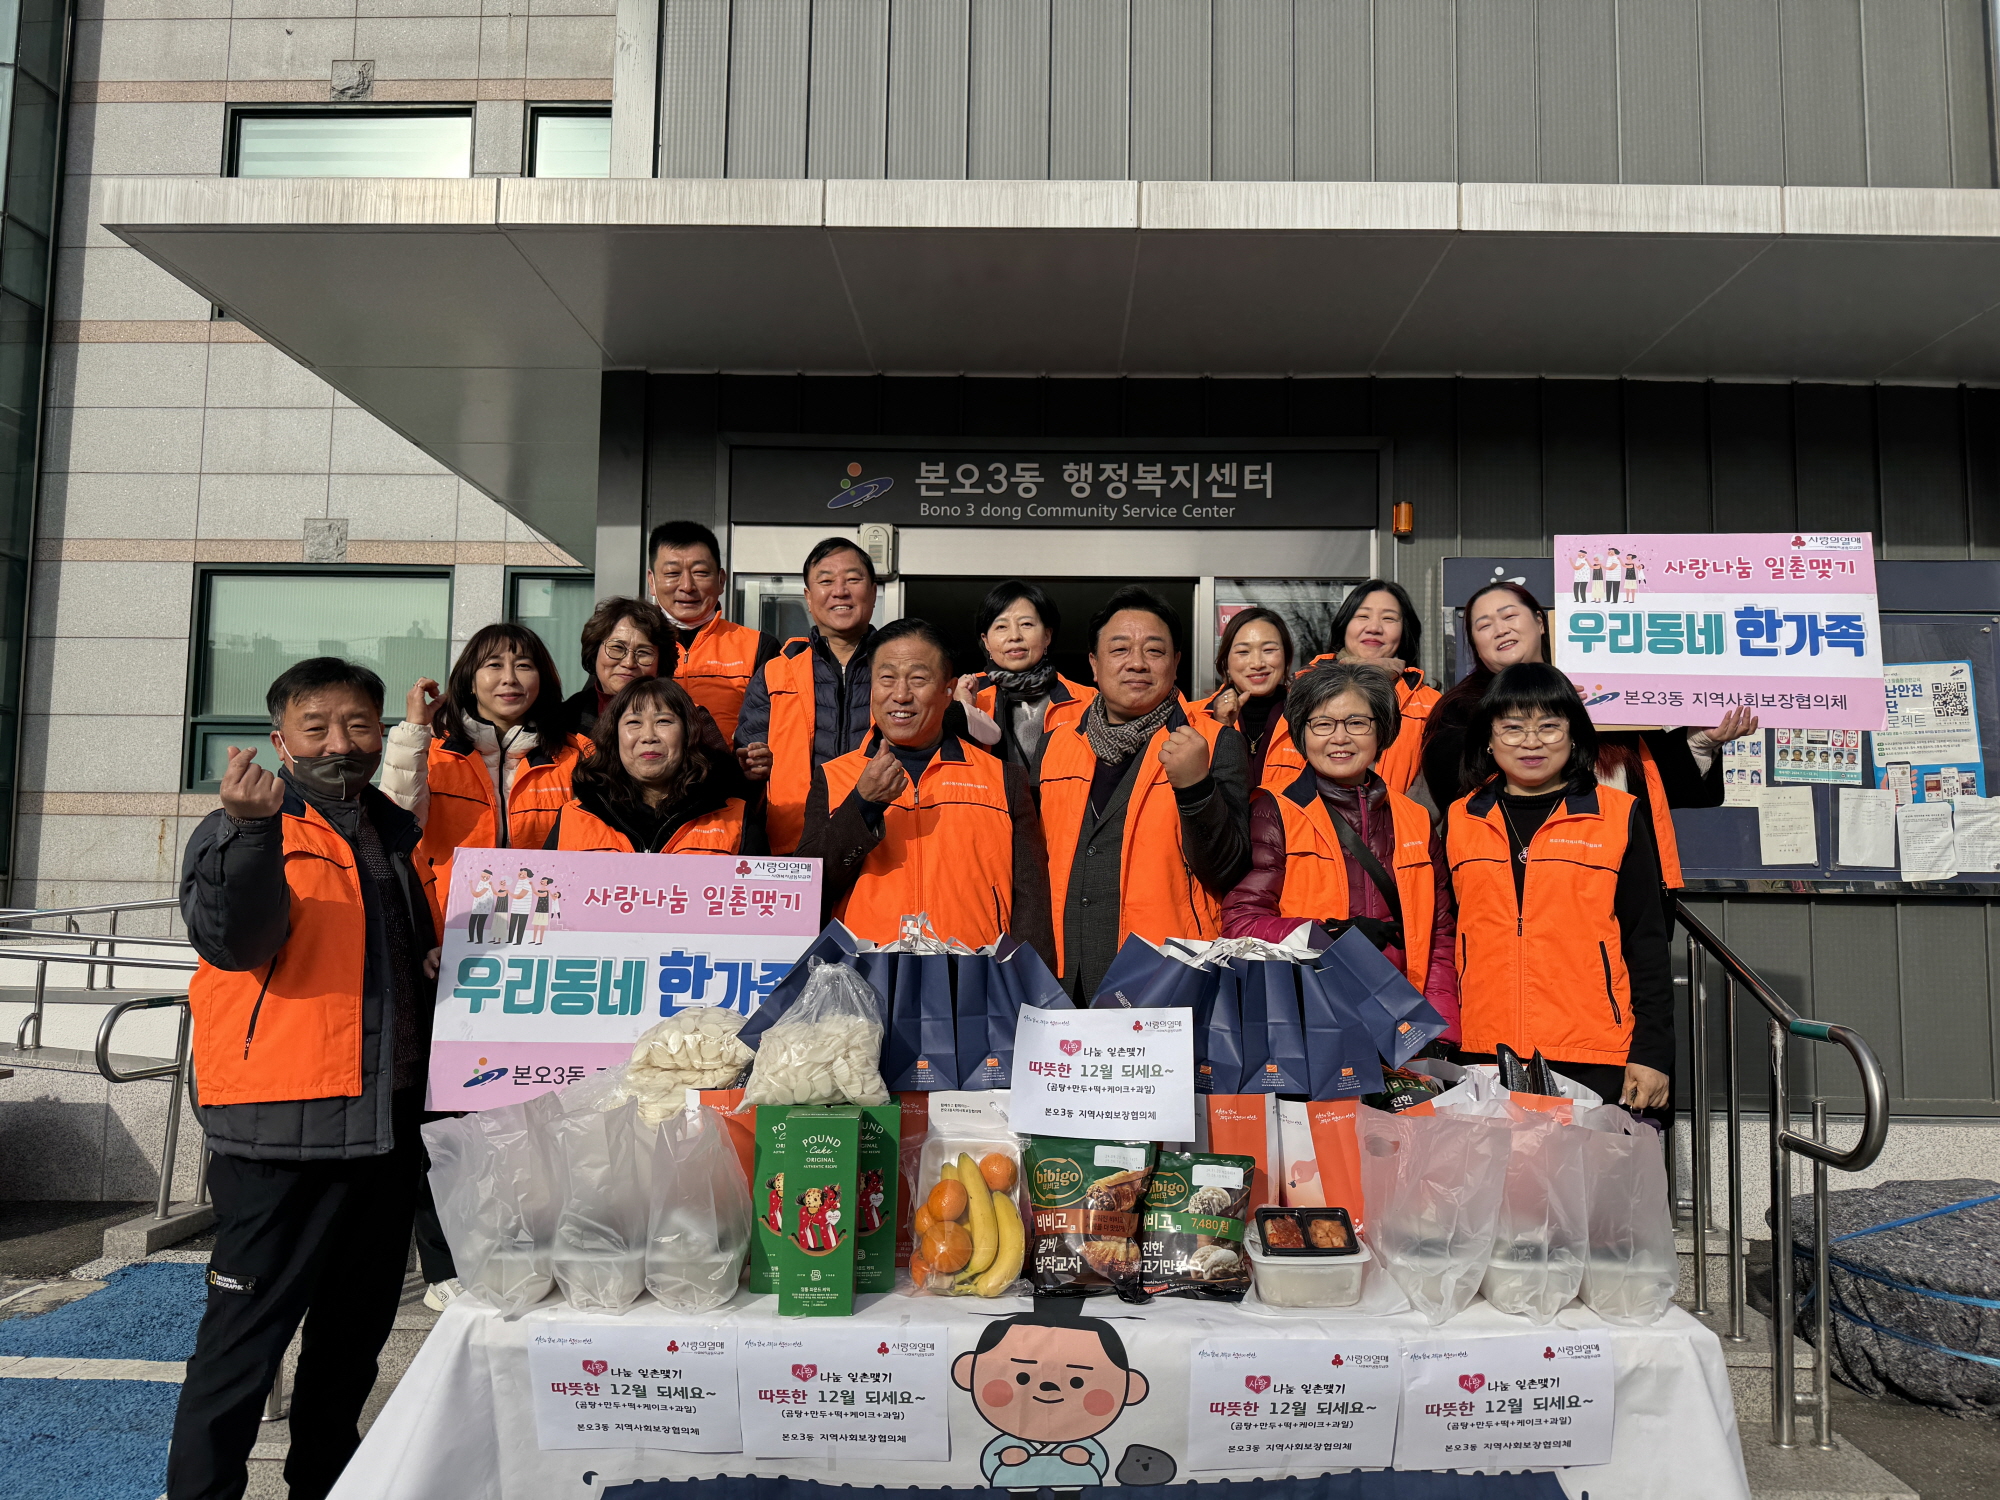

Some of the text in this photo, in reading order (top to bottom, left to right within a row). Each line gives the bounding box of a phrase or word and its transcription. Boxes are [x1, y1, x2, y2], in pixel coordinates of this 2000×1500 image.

[915, 462, 1274, 499] 본오3동 행정복지센터
[920, 503, 1236, 521] Bono 3 dong Community Service Center
[1808, 536, 1861, 546] 사랑의열매
[1664, 555, 1856, 581] 사랑나눔 일촌맺기
[1567, 605, 1867, 657] 우리동네 한가족
[1884, 683, 1924, 699] 난안전
[1623, 688, 1848, 711] 본오3동 지역사회보장협의체
[1885, 700, 1899, 714] 단
[1888, 714, 1927, 729] 로젝트
[754, 862, 812, 874] 사랑의열매
[583, 884, 802, 917] 사랑나눔 일촌맺기
[453, 955, 650, 1016] 우리동네
[1062, 1043, 1146, 1058] 사랑 나눔 일촌맺기
[512, 1064, 586, 1087] 본오3동
[1028, 1060, 1174, 1080] 따뜻한 12월 되세요~
[1046, 1082, 1156, 1095] (곰탕+만두+떡+케이크+과일)
[1390, 1094, 1414, 1107] 진한
[1044, 1107, 1157, 1120] 본오3동 지역사회보장협의체
[861, 1121, 884, 1134] UND
[802, 1134, 841, 1147] POUND
[809, 1145, 833, 1154] Cake
[1036, 1168, 1080, 1186] bibigo
[1042, 1182, 1060, 1190] 비비고
[1036, 1212, 1068, 1232] 비비고
[1037, 1236, 1058, 1254] 갈비
[1142, 1241, 1165, 1257] 진한
[1035, 1255, 1082, 1274] 납작교자
[215, 1280, 244, 1290] GEOGRAPHIC
[216, 1274, 238, 1284] NATIONAL
[586, 1363, 682, 1380] 사랑 나눔 일촌맺기
[795, 1366, 892, 1383] 사랑 나눔 일촌맺기
[551, 1382, 716, 1399] 따뜻한 12월 되세요~
[1248, 1378, 1345, 1395] 사랑 나눔 일촌맺기
[1463, 1377, 1560, 1392] 사랑 나눔 일촌맺기
[758, 1389, 926, 1405] 따뜻한 12월 되세요~
[575, 1401, 697, 1414] (곰탕+만두+떡+케이크+과일)
[1209, 1401, 1377, 1416] 따뜻한 12월 되세요~
[1425, 1395, 1594, 1417] 따뜻한 12월 되세요~
[781, 1409, 905, 1421] (곰탕+만두+떡+케이크+과일)
[577, 1423, 700, 1435] 본오3동 지역사회보장협의체
[1230, 1420, 1354, 1430] (곰탕+만두+떡+케이크+과일)
[1446, 1416, 1572, 1430] (곰탕+만두+떡+케이크+과일)
[782, 1433, 907, 1443] 본오3동 지역사회보장협의체
[1228, 1442, 1352, 1453] 본오3동 지역사회보장협의체
[1445, 1440, 1572, 1453] 본오3동 지역사회보장협의체
